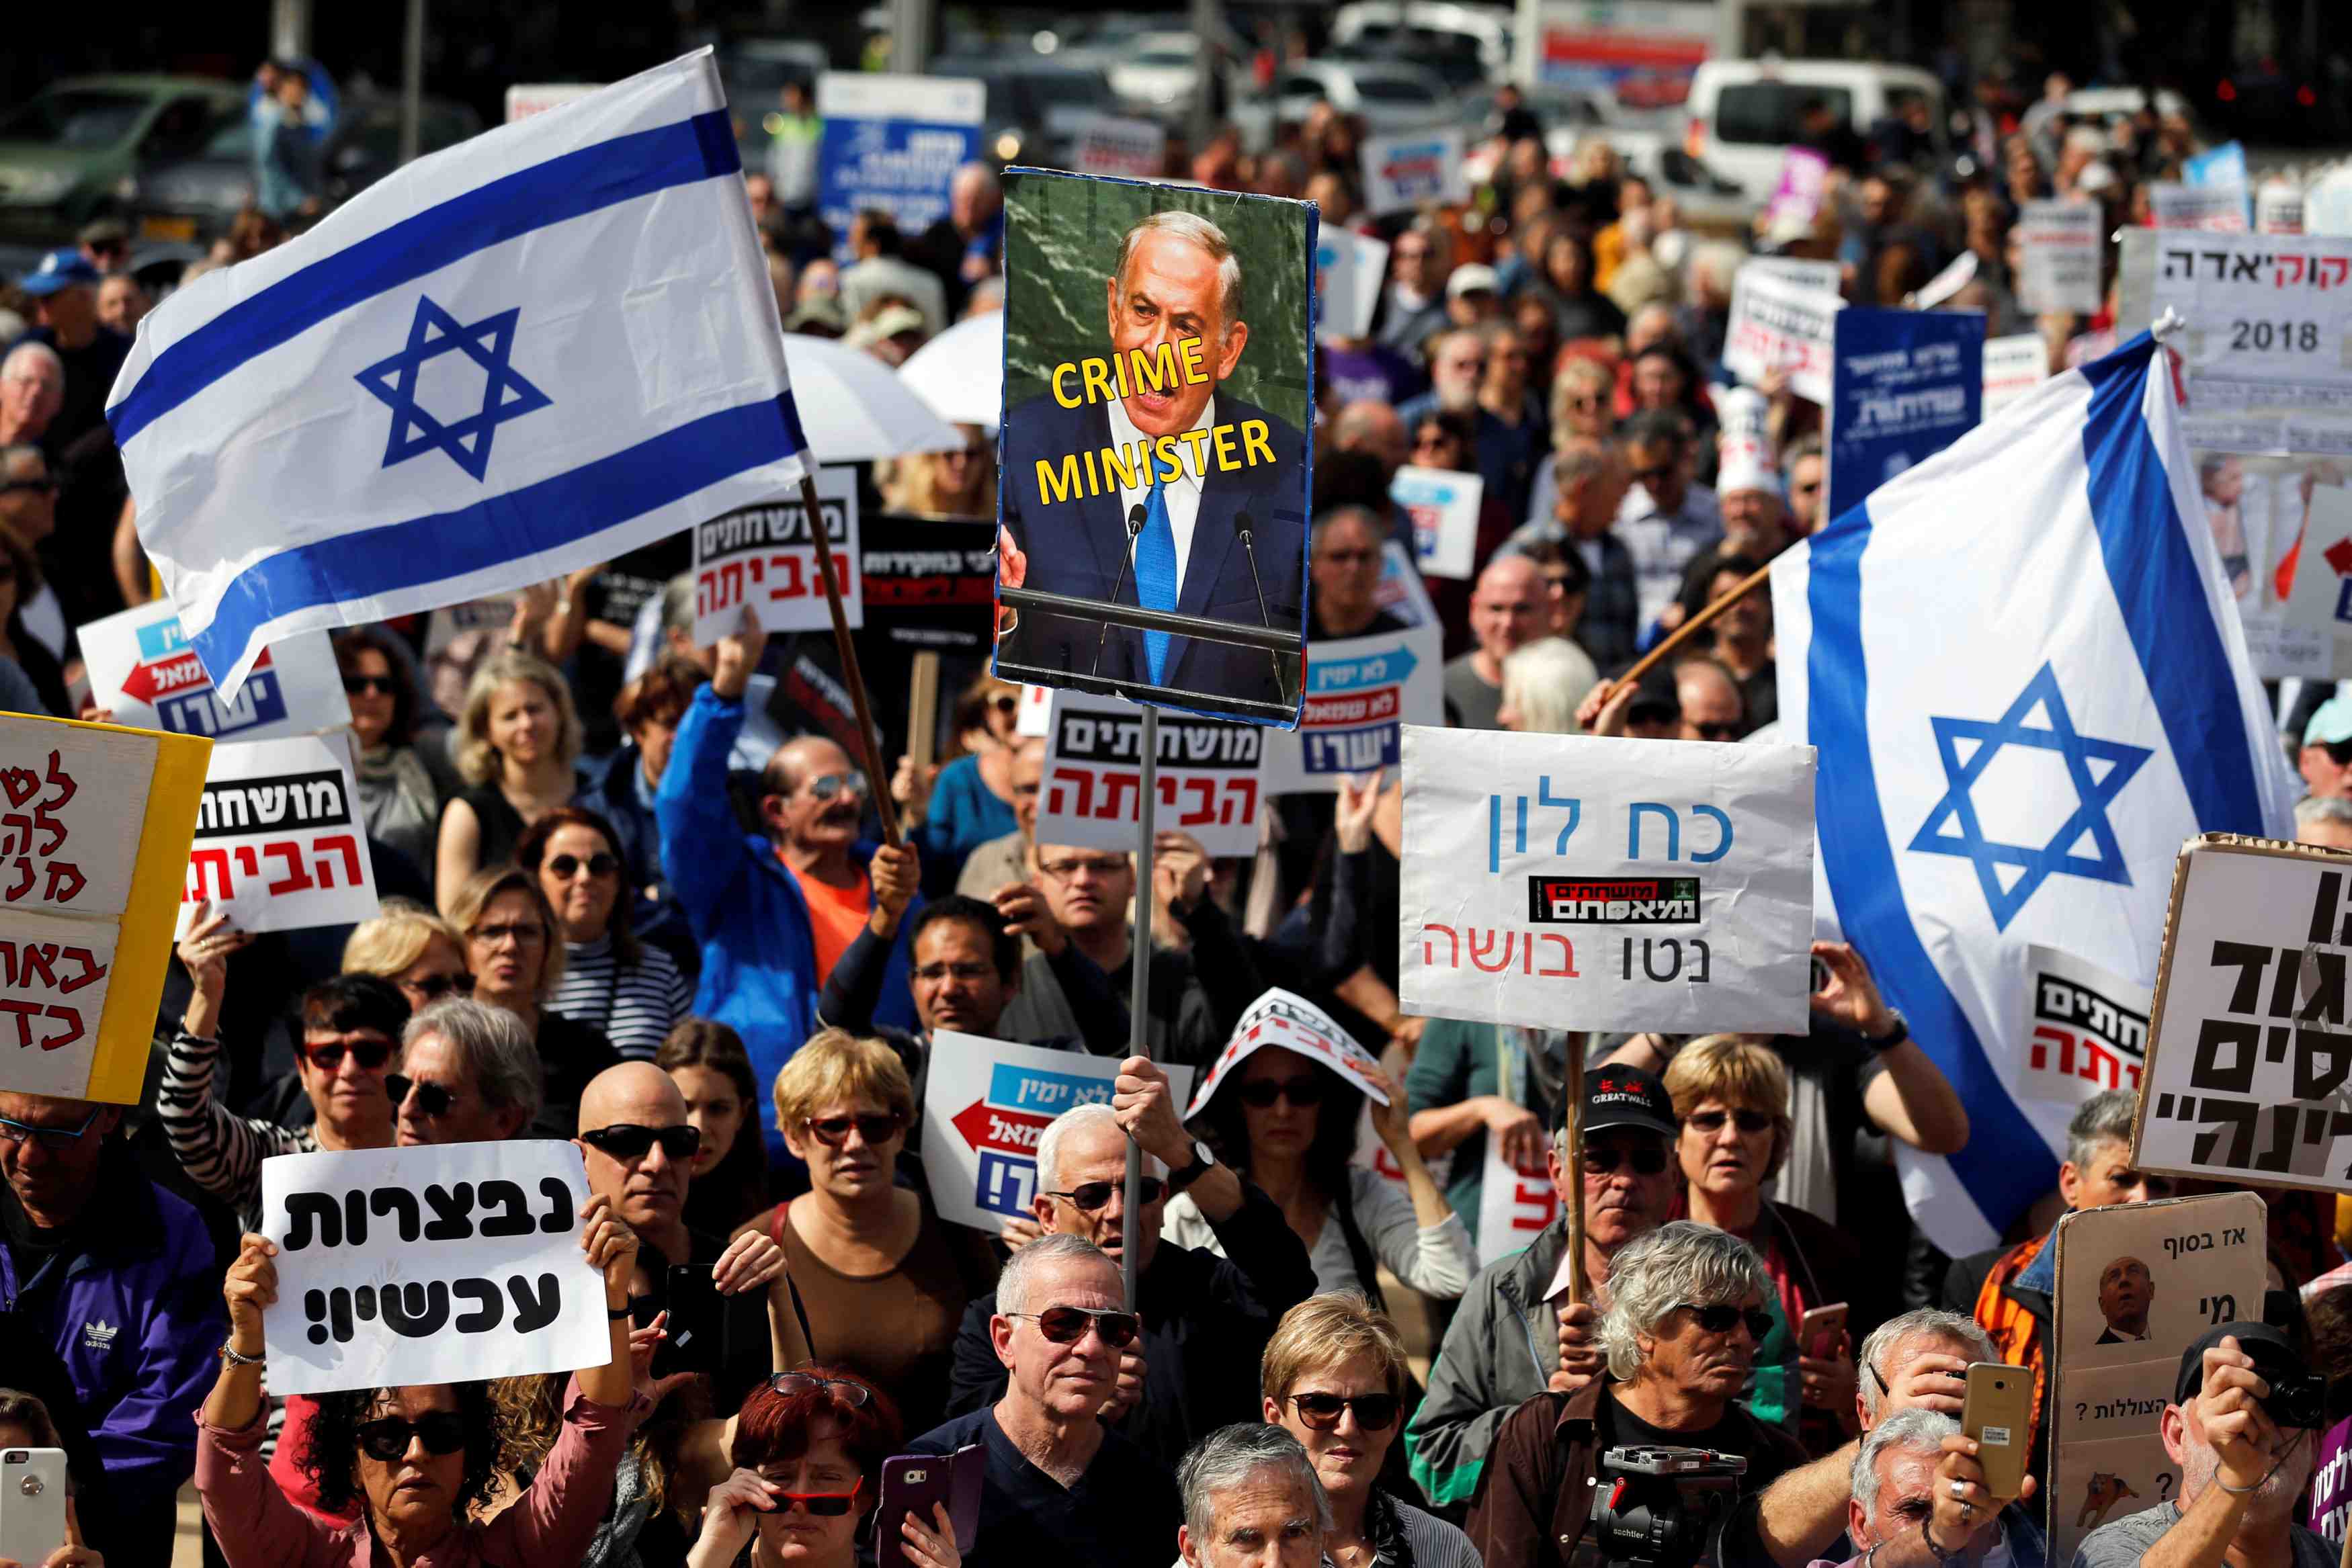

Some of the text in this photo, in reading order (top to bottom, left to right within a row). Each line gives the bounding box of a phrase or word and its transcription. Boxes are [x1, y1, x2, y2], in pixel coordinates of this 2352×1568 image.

[2165, 250, 2348, 290] קוקיאדה
[2232, 320, 2318, 352] 2018
[1051, 336, 1209, 409] CRIME
[1035, 419, 1276, 505] MINISTER
[151, 663, 206, 691] מאל
[1064, 718, 1259, 760] מושחתים
[1312, 727, 1391, 770] ישר!
[1048, 767, 1257, 826] הביתה
[181, 835, 364, 902] הבית
[1552, 900, 1695, 920] נמאסתם
[1555, 885, 1653, 898] מושחתים
[1424, 924, 1710, 983] נטו בושה
[2044, 982, 2148, 1051] חתים
[1017, 1078, 1068, 1104] ימין
[989, 1113, 1046, 1149] מאל
[283, 1177, 574, 1252] נבצרות
[2163, 1227, 2246, 1260] אז בסוף
[304, 1272, 560, 1345] עכשיו!
[2199, 1295, 2236, 1324] מי
[85, 1340, 110, 1350] adidas
